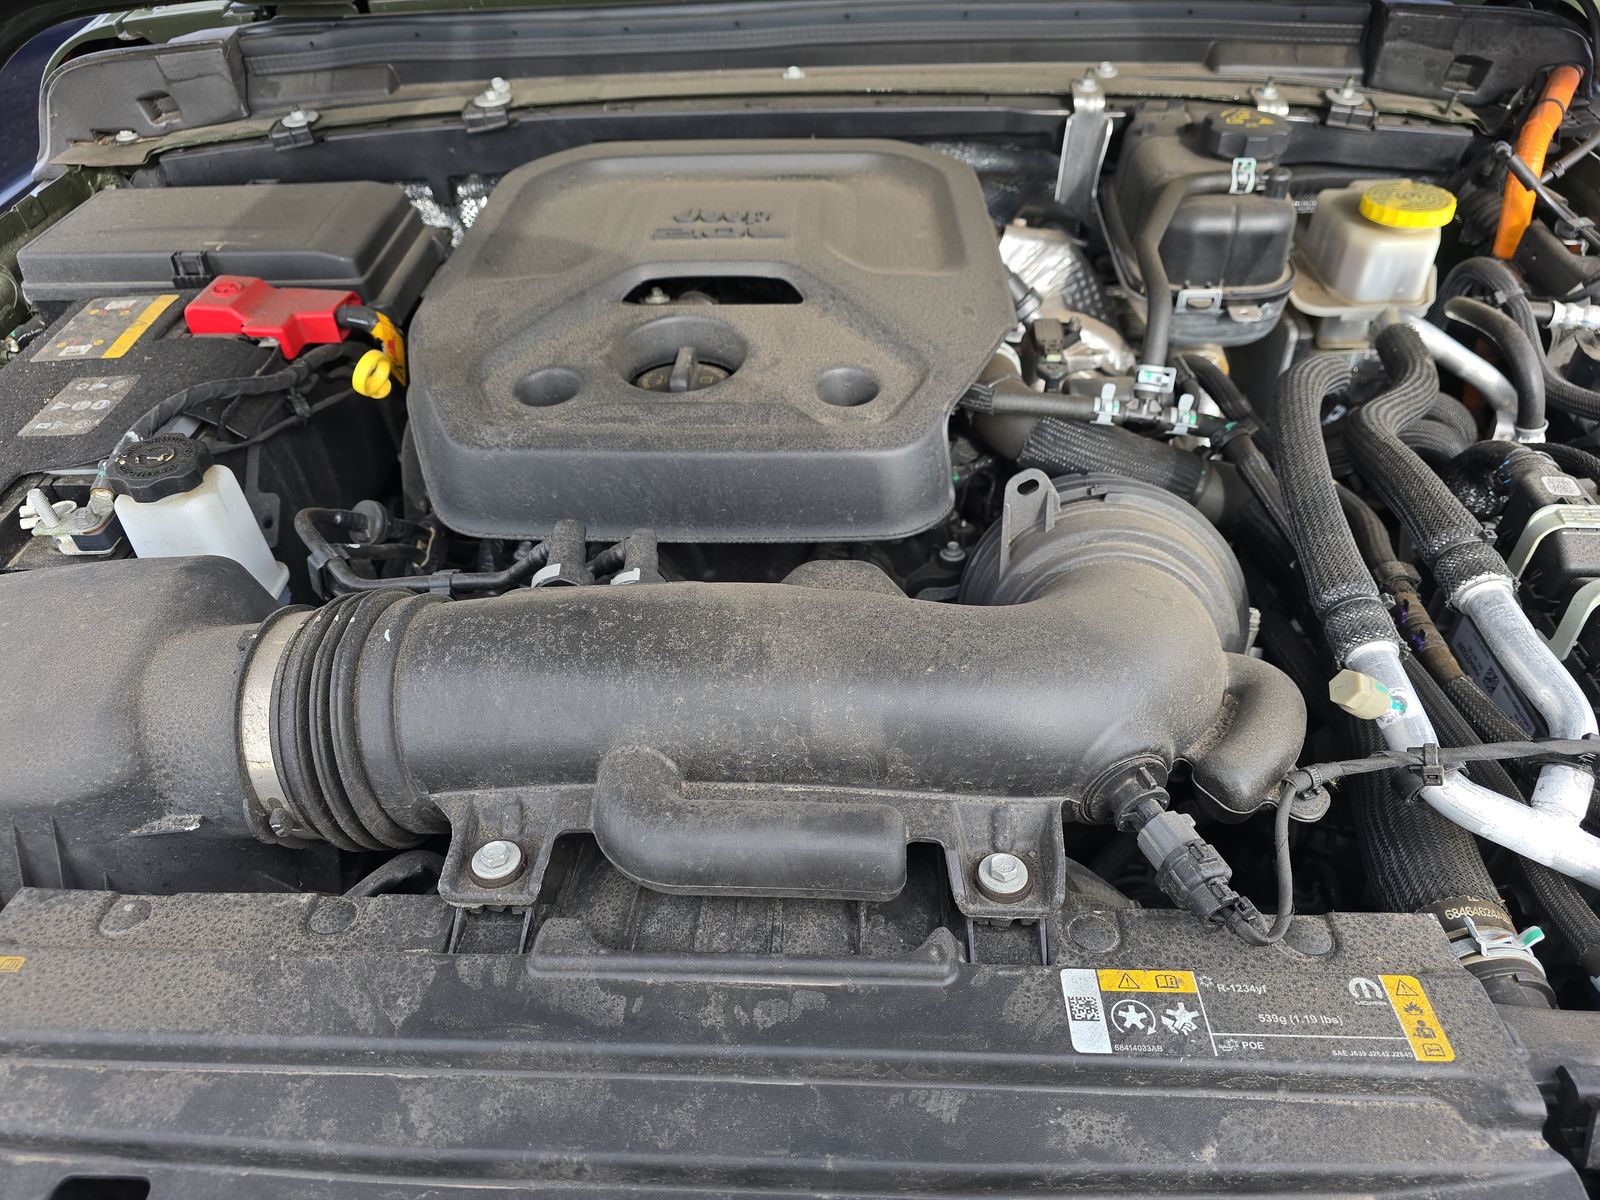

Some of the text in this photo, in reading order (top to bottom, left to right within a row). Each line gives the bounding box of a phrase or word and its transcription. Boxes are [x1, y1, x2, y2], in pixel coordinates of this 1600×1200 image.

[672, 207, 771, 226] Jeep
[1216, 983, 1266, 995] R-1234yf
[1258, 1013, 1343, 1027] 539g (1.19 lbs)
[1242, 1041, 1265, 1050] POE
[1331, 1049, 1348, 1057] SAE
